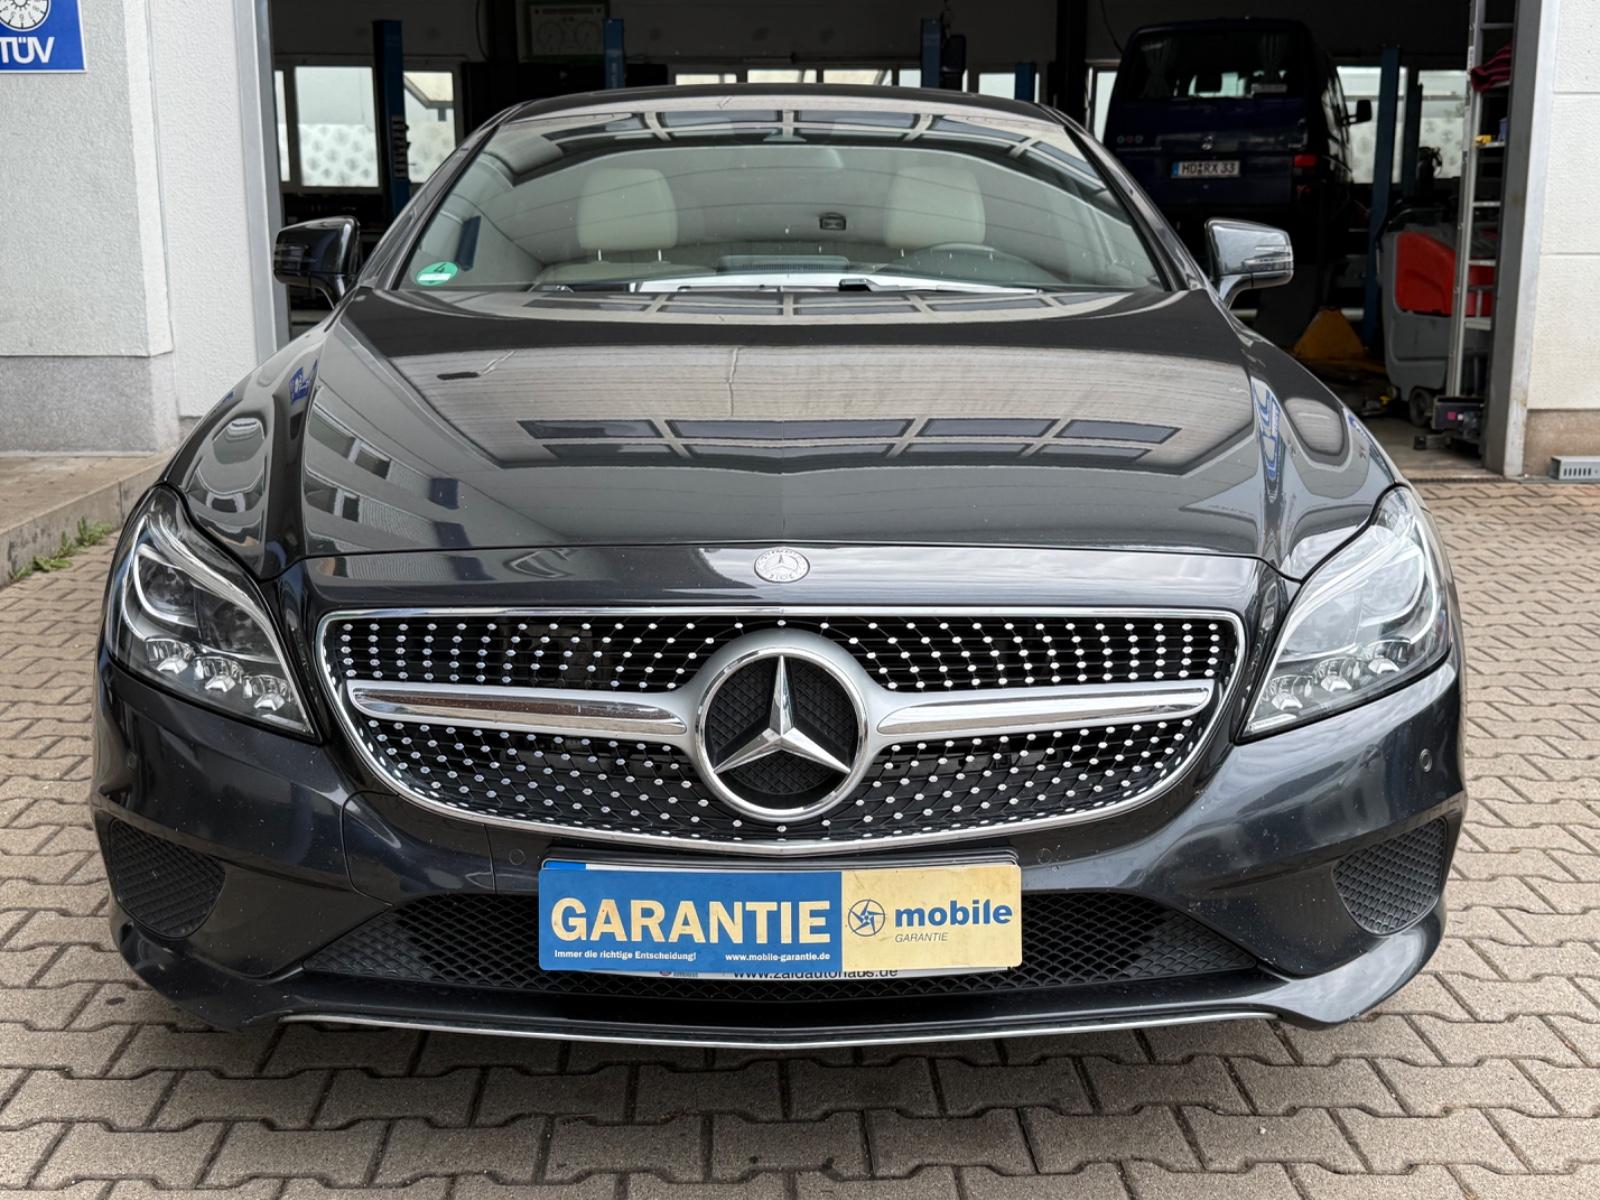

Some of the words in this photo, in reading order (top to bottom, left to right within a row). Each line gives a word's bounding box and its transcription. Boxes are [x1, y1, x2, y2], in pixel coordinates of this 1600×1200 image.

[0, 36, 55, 64] TÜV
[434, 263, 447, 273] 4
[551, 897, 831, 945] GARANTIE
[895, 899, 1013, 928] mobile
[895, 931, 949, 943] GARANTIE
[554, 950, 582, 958] Immer
[584, 950, 598, 958] die
[600, 950, 633, 961] richtige
[635, 951, 697, 962] Entscheidung!
[725, 952, 831, 962] www.mobile-garantie.de
